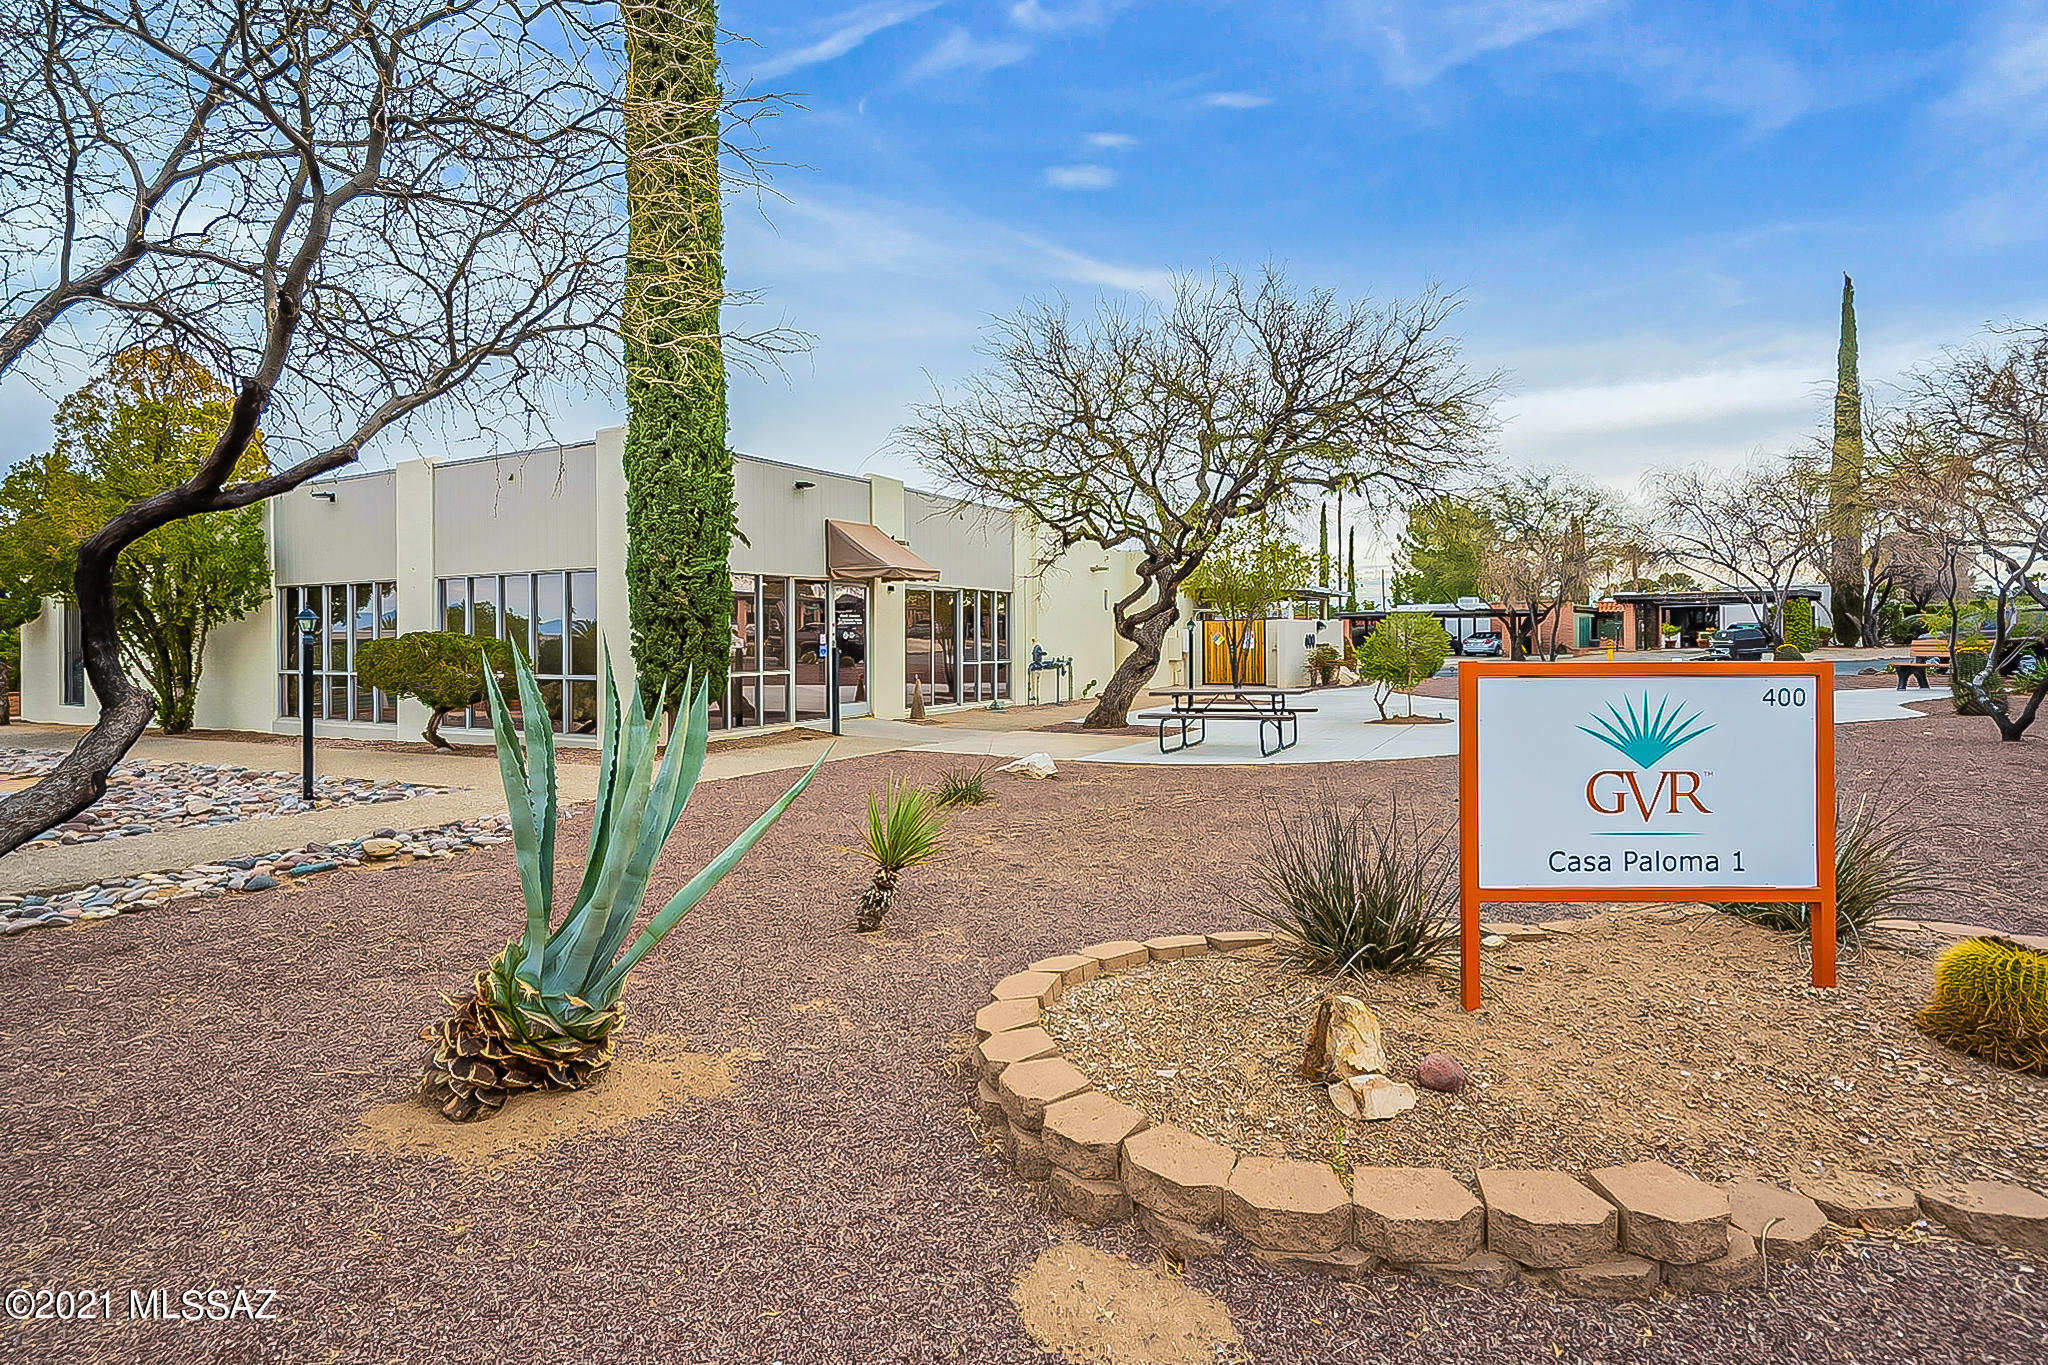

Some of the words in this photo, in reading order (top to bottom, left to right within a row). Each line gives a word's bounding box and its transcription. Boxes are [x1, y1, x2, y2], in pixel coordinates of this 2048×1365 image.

[1761, 687, 1806, 708] 400
[1585, 769, 1714, 823] GVR
[1547, 850, 1612, 873] Casa
[1623, 850, 1719, 873] Paloma
[1732, 850, 1746, 872] 1
